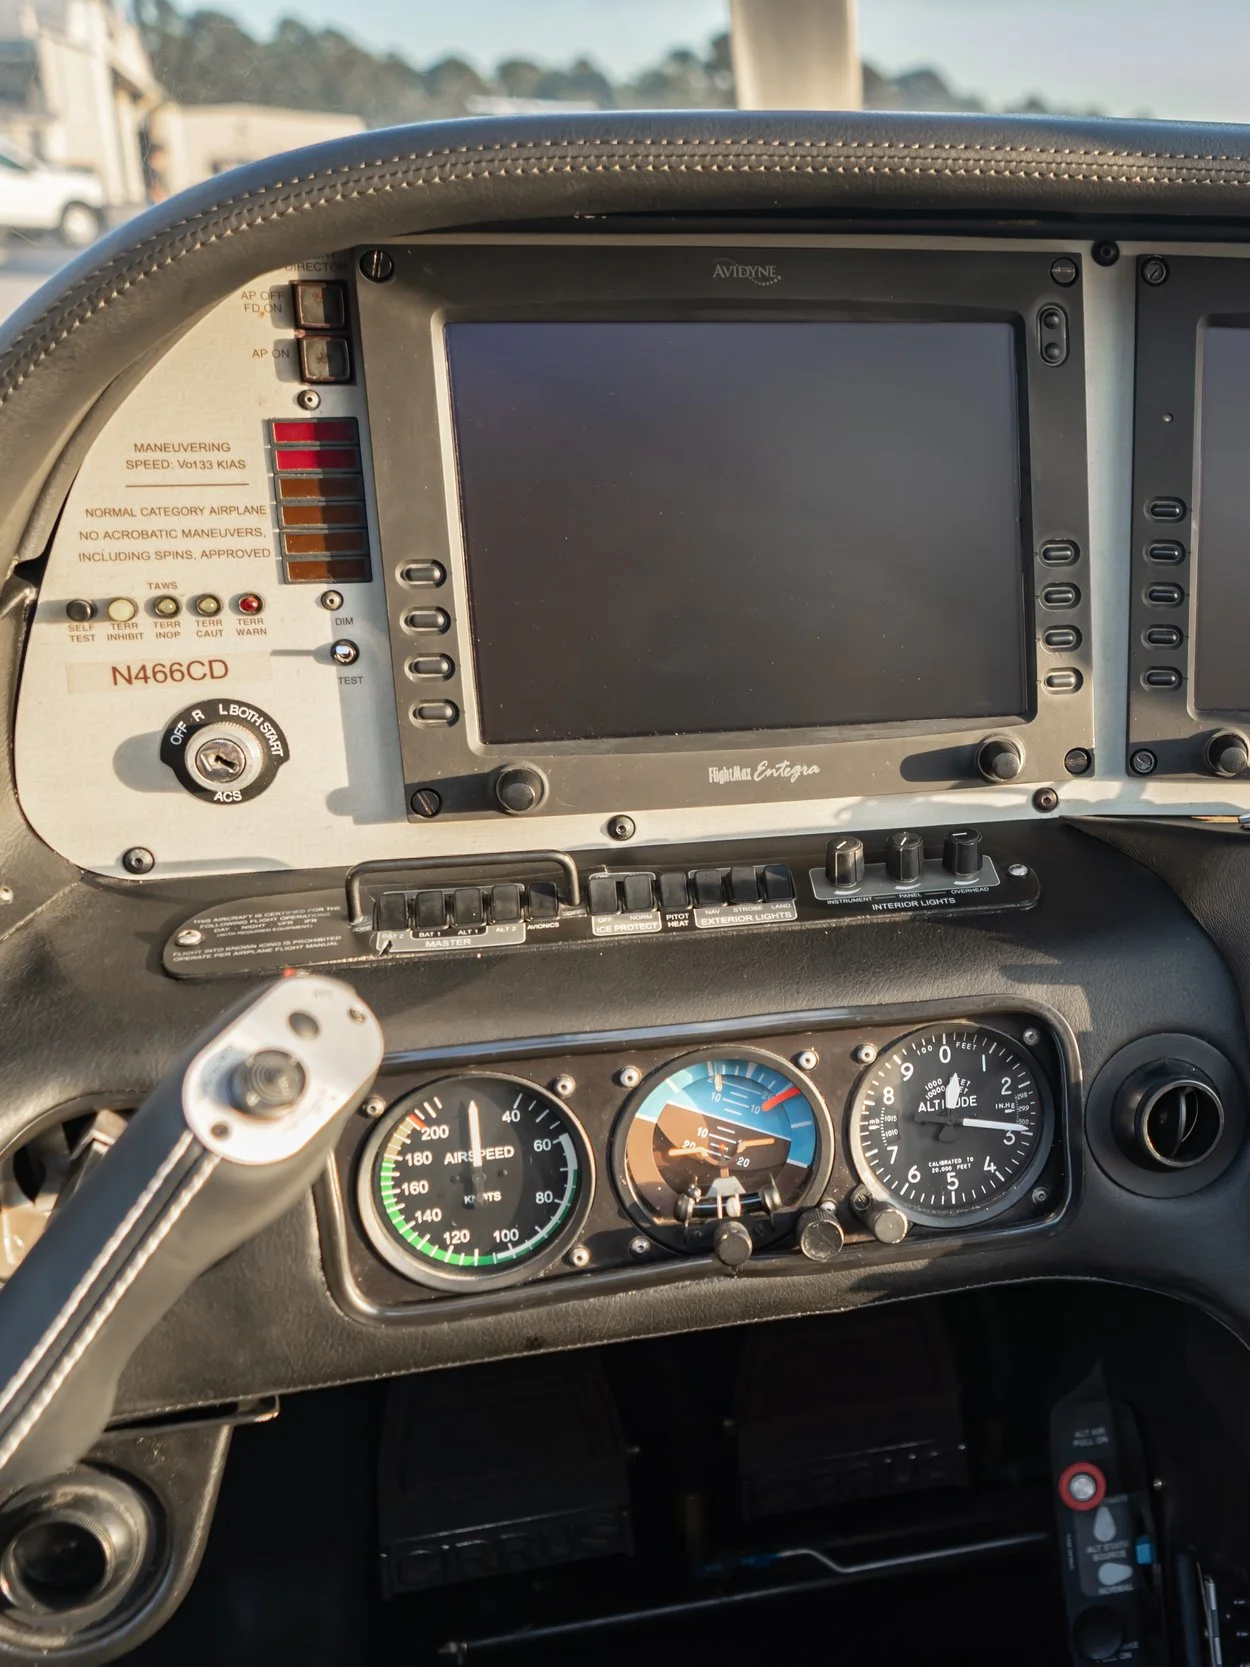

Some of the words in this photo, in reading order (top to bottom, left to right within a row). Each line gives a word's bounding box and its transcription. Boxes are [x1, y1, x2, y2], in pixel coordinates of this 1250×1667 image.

[712, 263, 777, 279] AVIDYNE
[241, 291, 256, 300] AP
[260, 291, 284, 300] OFF
[244, 304, 260, 312] FD
[264, 304, 282, 313] ON
[252, 349, 268, 358] AP
[272, 349, 290, 359] ON
[134, 442, 231, 453] MANEUVERING
[126, 460, 173, 470] SPEED:
[177, 460, 213, 469] Vo133
[217, 460, 246, 469] KIAS
[85, 507, 136, 518] NORMAL
[140, 506, 205, 517] CATEGORY
[209, 505, 267, 516] AIRPLANE
[79, 531, 99, 541] NO
[103, 529, 178, 540] ACROBATIC
[182, 528, 266, 539] MANEUVERS,
[79, 551, 151, 562] INCLUDING
[155, 549, 197, 561] SPINS,
[201, 549, 271, 560] APPROVED
[148, 582, 178, 590] TAWS
[111, 622, 139, 631] TERR
[153, 620, 182, 629] TERR
[195, 619, 223, 628] TERR
[236, 618, 265, 626] TERR
[335, 617, 354, 626] DIM
[68, 624, 95, 633] SELF
[196, 629, 224, 638] CAUT
[236, 628, 268, 637] WARN
[69, 634, 97, 643] TEST
[107, 632, 144, 641] INHIBIT
[156, 631, 181, 640] INOP
[111, 659, 229, 687] N466CD
[338, 676, 364, 685] TEST
[170, 720, 187, 745] OFF
[192, 709, 205, 722] R
[219, 704, 228, 715] L
[230, 704, 264, 726] BOTH
[260, 722, 284, 757] START
[708, 765, 752, 784] FlightMax
[753, 760, 820, 783] Entegra
[214, 791, 242, 802] ACS
[950, 887, 990, 895] OVERHEAD
[827, 896, 873, 905] INSTRUMENT
[872, 901, 919, 911] INTERIOR
[921, 897, 956, 907] LIGHTS
[733, 905, 764, 913] STROBE
[213, 914, 252, 922] AIRCRAFT
[264, 909, 306, 917] CERTIFIED
[666, 913, 690, 921] PITOT
[701, 914, 753, 926] EXTERIOR
[755, 911, 792, 922] LIGHTS
[527, 922, 560, 930] AVIONICS
[596, 925, 613, 934] ICE
[614, 922, 658, 932] PROTECT
[667, 920, 689, 928] HEAT
[233, 948, 273, 956] AIRPLANE
[305, 941, 339, 949] MANUAL
[425, 938, 472, 948] MASTER
[916, 1045, 933, 1056] 100
[956, 1041, 977, 1050] FEET
[939, 1045, 952, 1064] 0
[900, 1063, 914, 1082] 9
[1001, 1077, 1012, 1096] 2
[711, 1092, 722, 1103] 10
[883, 1087, 894, 1105] 8
[918, 1095, 978, 1112] ALTIUDE
[502, 1110, 521, 1124] 40
[421, 1125, 449, 1141] 200
[533, 1139, 551, 1152] 60
[405, 1152, 432, 1166] 180
[887, 1146, 898, 1165] 7
[736, 1157, 751, 1168] 20
[928, 1158, 962, 1168] CALIBRATED
[983, 1156, 997, 1173] 4
[908, 1165, 921, 1183] 6
[947, 1172, 959, 1190] 5
[402, 1181, 429, 1196] 160
[535, 1191, 553, 1204] 80
[415, 1209, 442, 1224] 140
[443, 1230, 471, 1245] 120
[493, 1229, 519, 1243] 100
